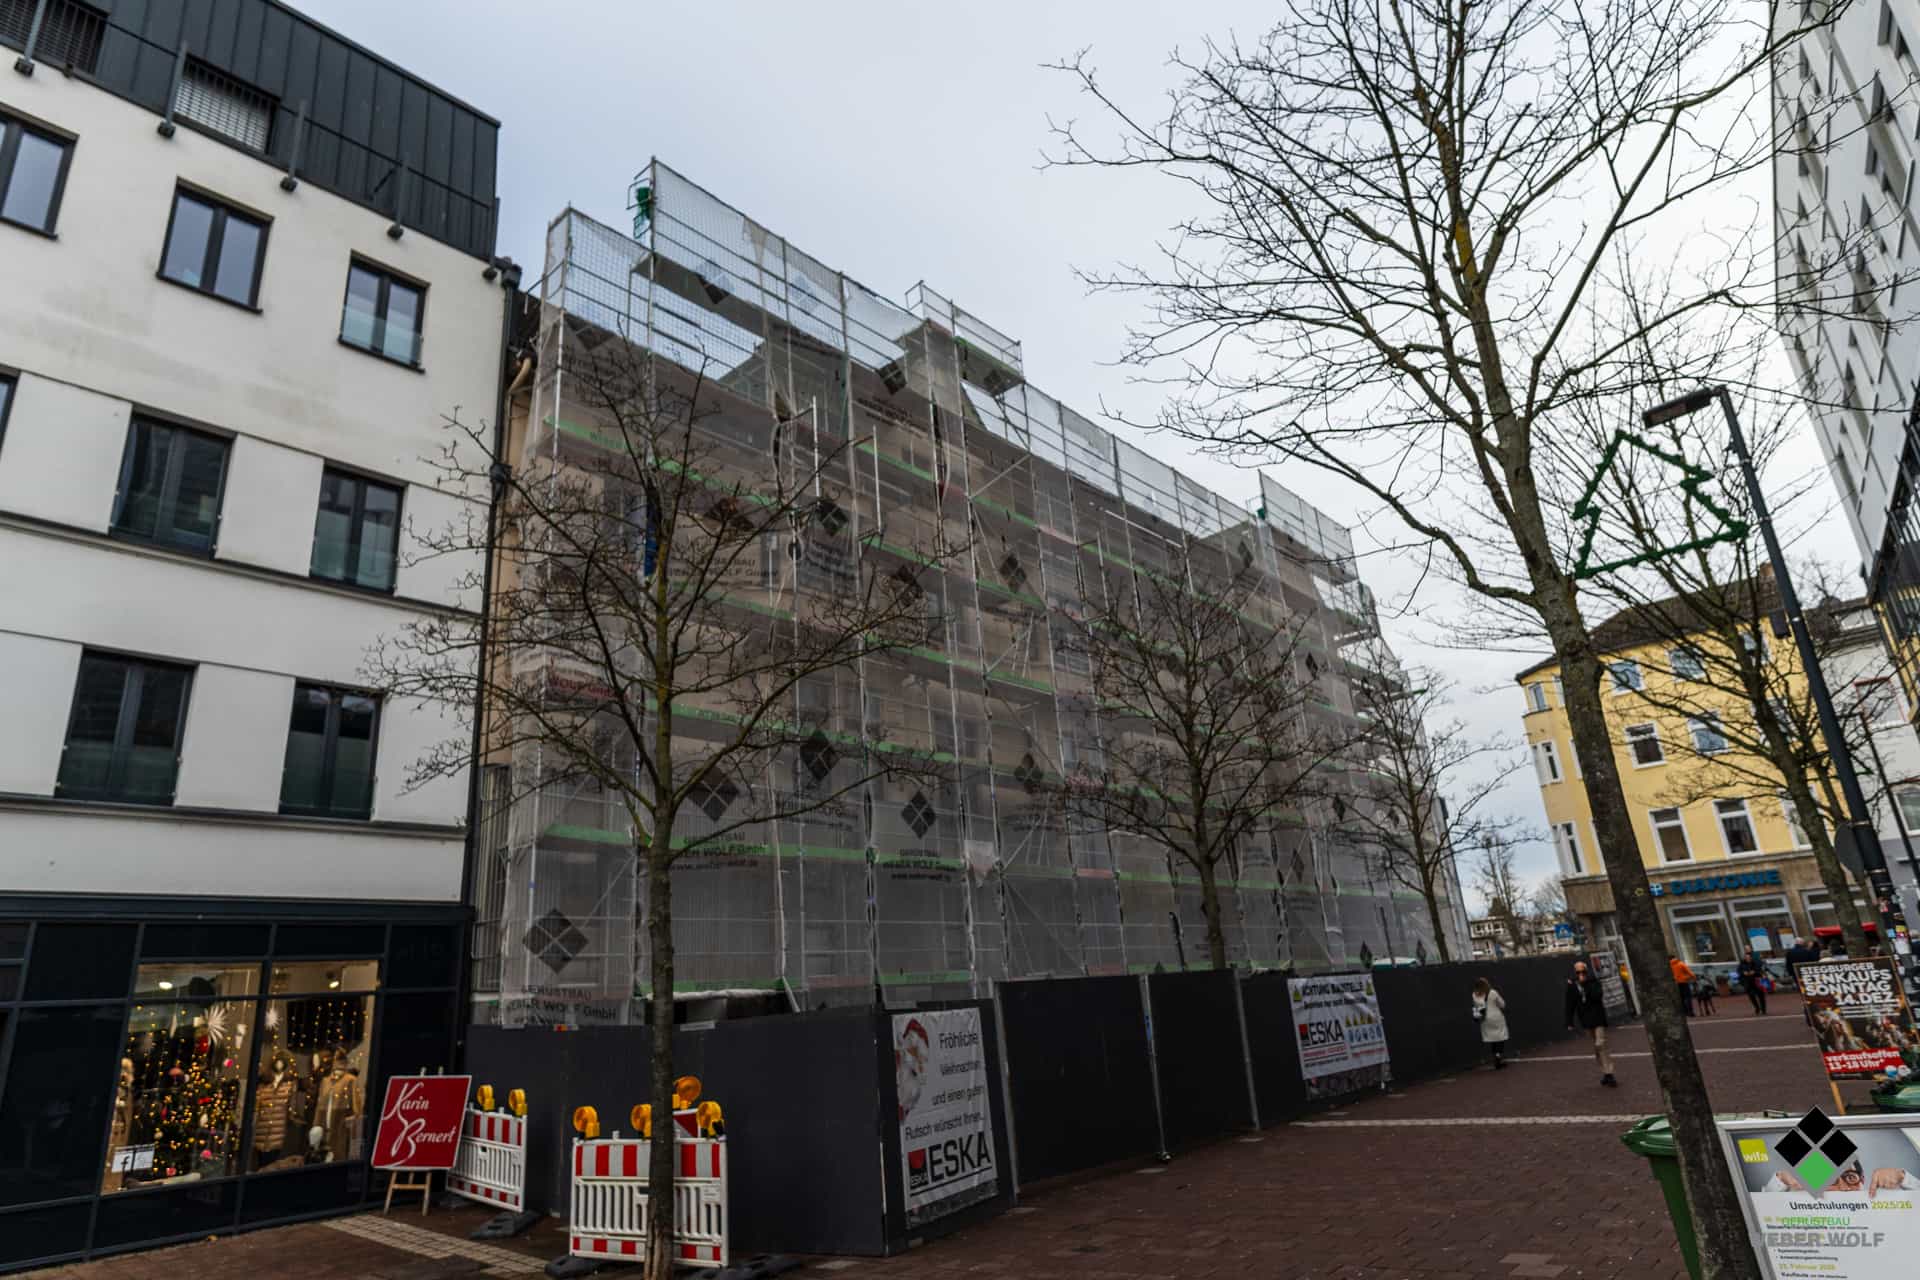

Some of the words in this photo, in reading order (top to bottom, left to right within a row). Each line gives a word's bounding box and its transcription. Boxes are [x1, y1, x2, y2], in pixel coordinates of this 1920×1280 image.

[1800, 962, 1874, 975] SIEGBURGER
[1802, 969, 1892, 985] EINKAUFS
[1805, 981, 1891, 996] SONNTAG
[583, 1005, 617, 1020] GmbH
[1308, 1019, 1345, 1045] ESKA
[383, 1082, 430, 1120] Karin
[928, 1131, 991, 1183] ESKA
[1790, 1200, 1868, 1212] Umschulungen
